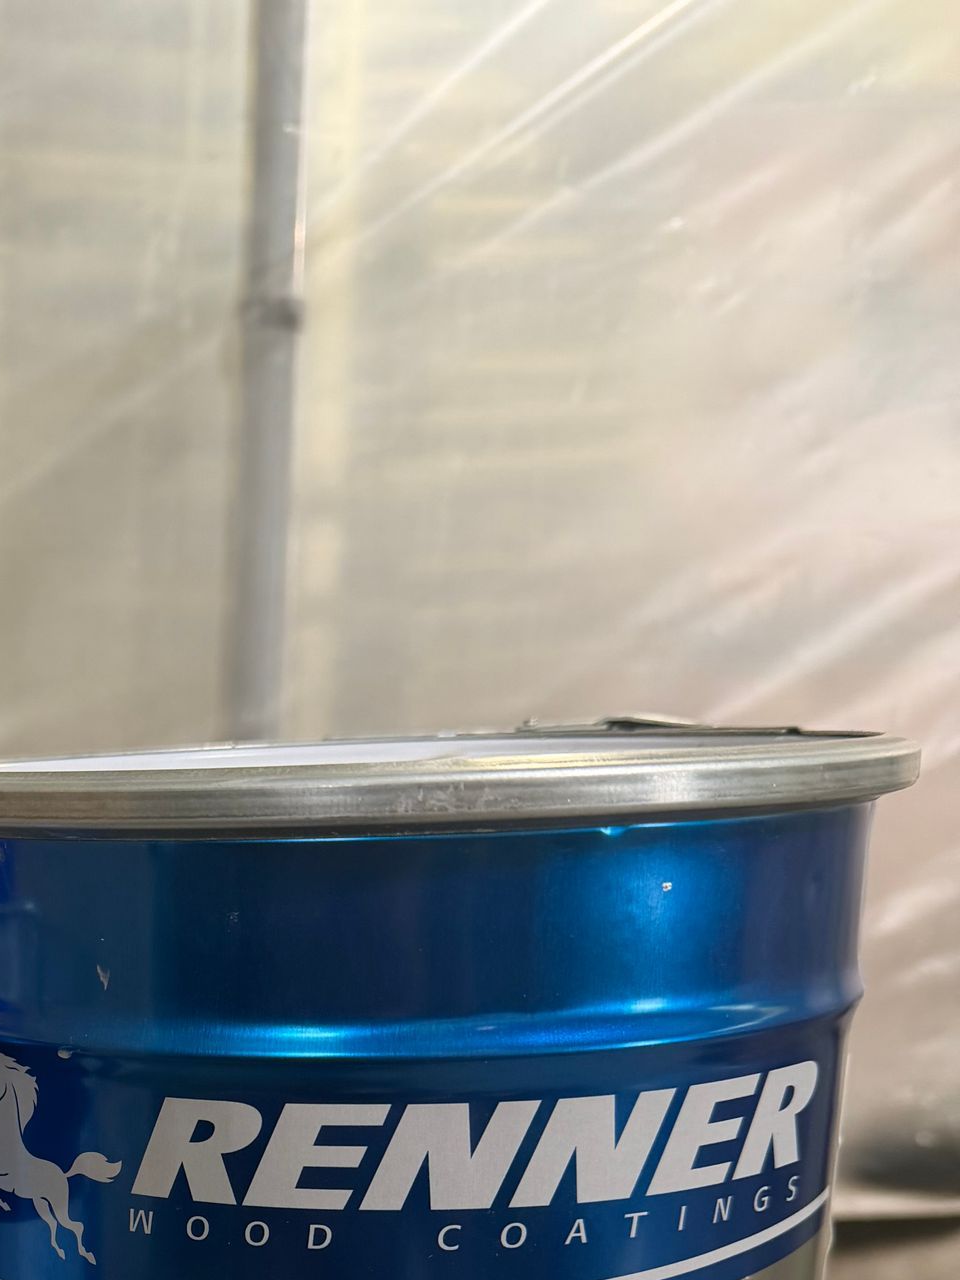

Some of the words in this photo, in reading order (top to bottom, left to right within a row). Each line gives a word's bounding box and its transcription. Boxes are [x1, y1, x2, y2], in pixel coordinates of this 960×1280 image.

[131, 1059, 818, 1212] RENNER
[129, 1208, 331, 1251] WOOD
[438, 1175, 801, 1252] COATINGS
